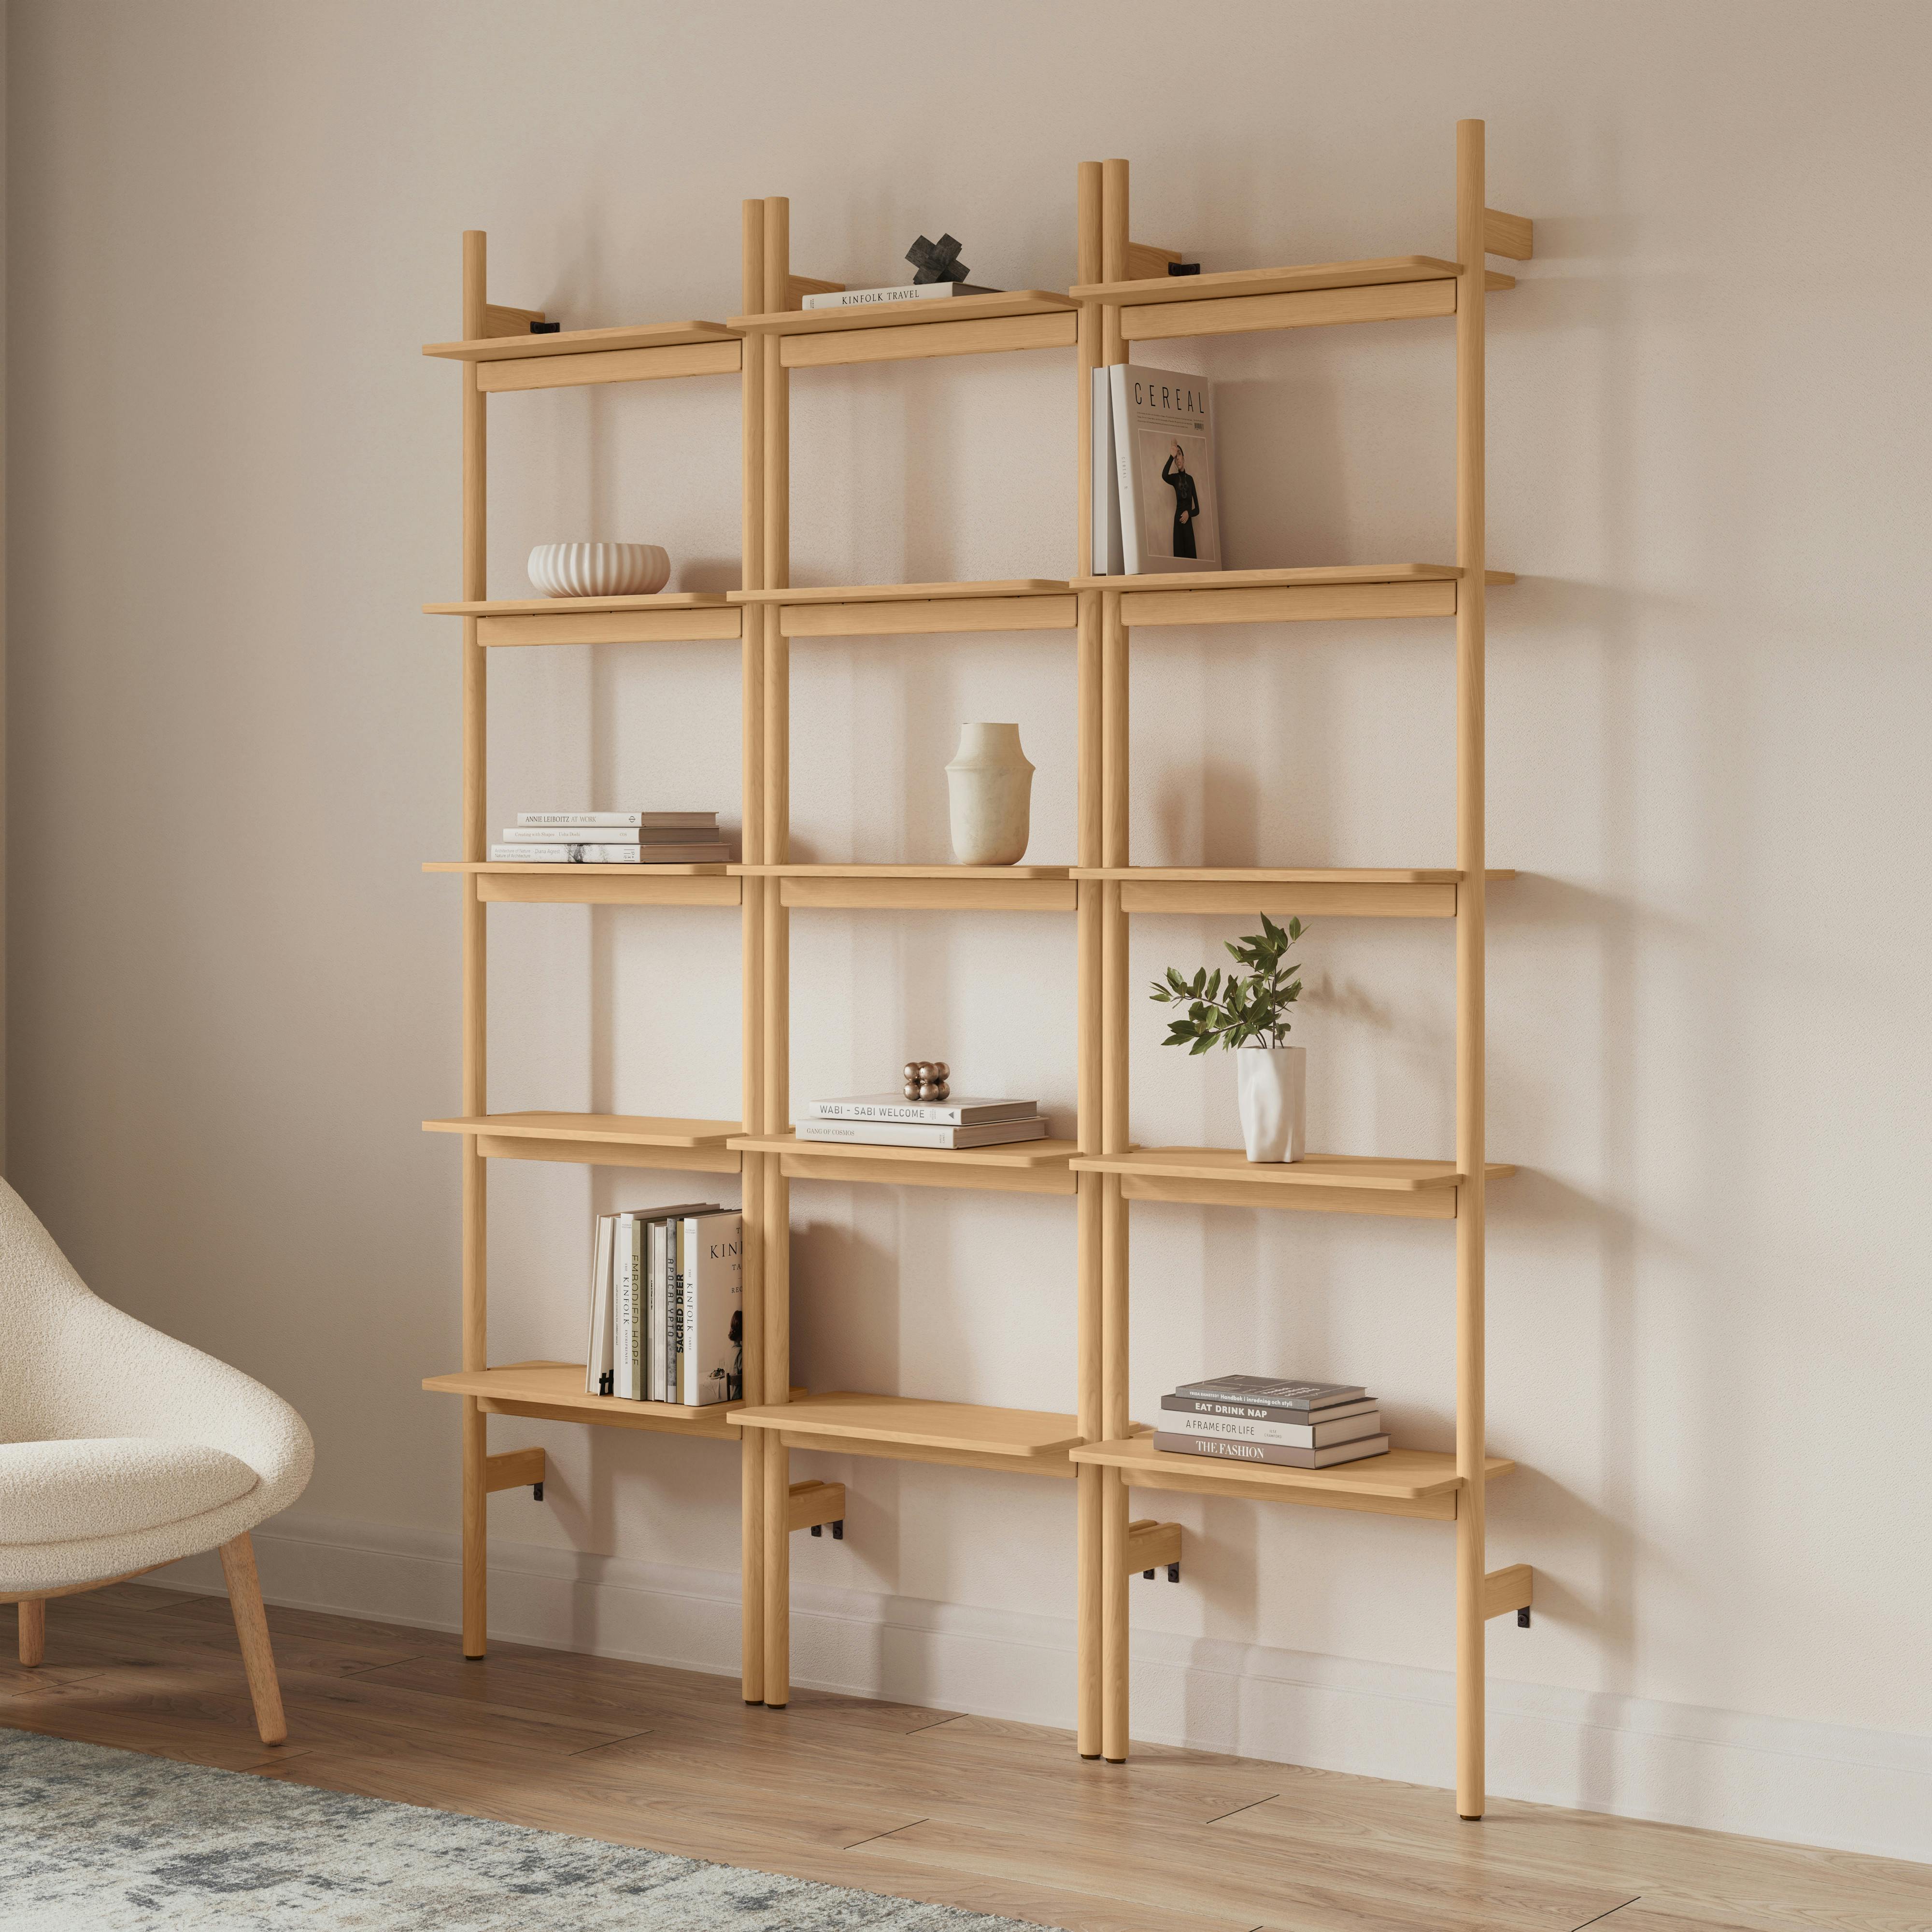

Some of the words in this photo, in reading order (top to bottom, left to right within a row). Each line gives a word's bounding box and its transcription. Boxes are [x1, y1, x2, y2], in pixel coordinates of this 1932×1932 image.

[842, 293, 883, 304] KINFOLK
[887, 290, 919, 300] TRAVEL
[1135, 382, 1204, 413] CEREAL
[820, 1105, 842, 1114] WABI
[854, 1107, 875, 1116] SABI
[879, 1108, 924, 1118] WELCOME
[1195, 1403, 1212, 1411] EAT
[1215, 1405, 1245, 1416] DRINK
[1248, 1409, 1267, 1418] NAP
[1186, 1420, 1191, 1428] A
[1193, 1421, 1220, 1431] FRAME
[1222, 1423, 1236, 1433] FOR
[1238, 1425, 1255, 1435] LIFE
[1196, 1440, 1218, 1453] THE
[1219, 1443, 1264, 1459] FASHION
